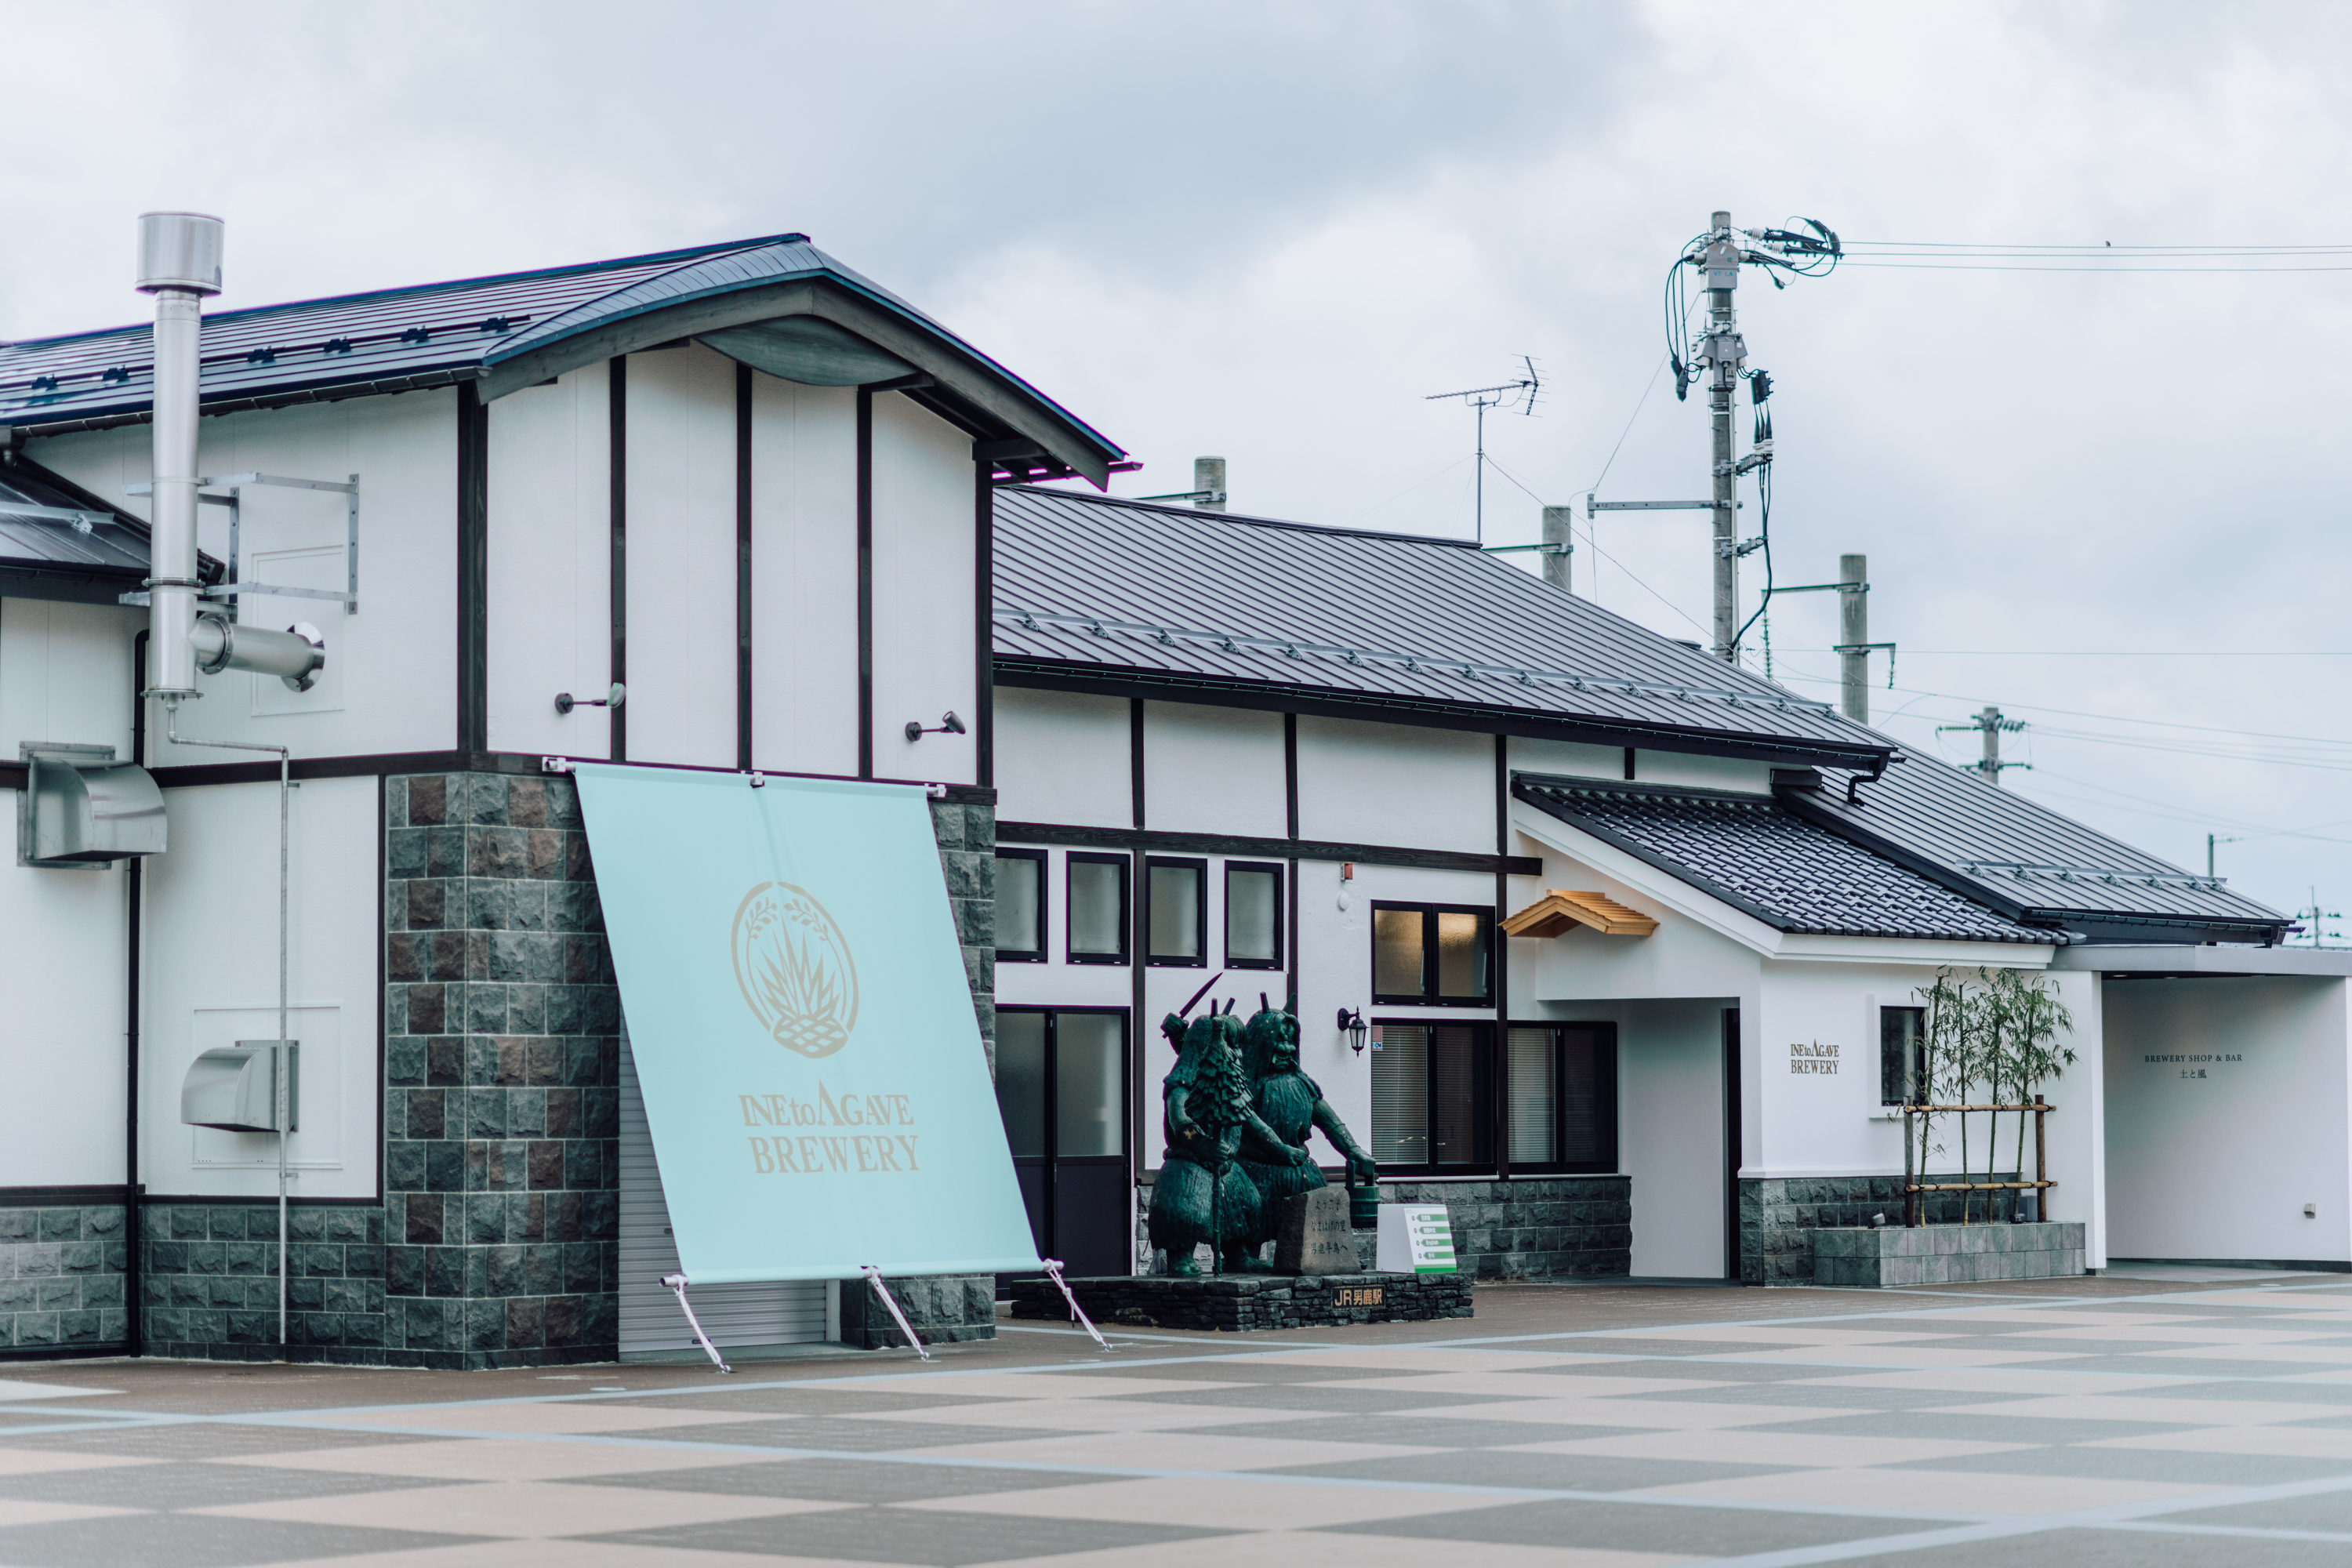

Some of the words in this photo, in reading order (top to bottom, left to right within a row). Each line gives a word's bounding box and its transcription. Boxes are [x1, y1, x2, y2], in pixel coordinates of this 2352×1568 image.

[1791, 1059, 1839, 1074] BREWERY
[2180, 1069, 2207, 1079] 土と風
[747, 1134, 920, 1174] BREWERY
[1315, 1196, 1341, 1210] ようこそ
[1312, 1220, 1346, 1232] なまはげの里
[1311, 1241, 1348, 1254] 男鹿半島へ
